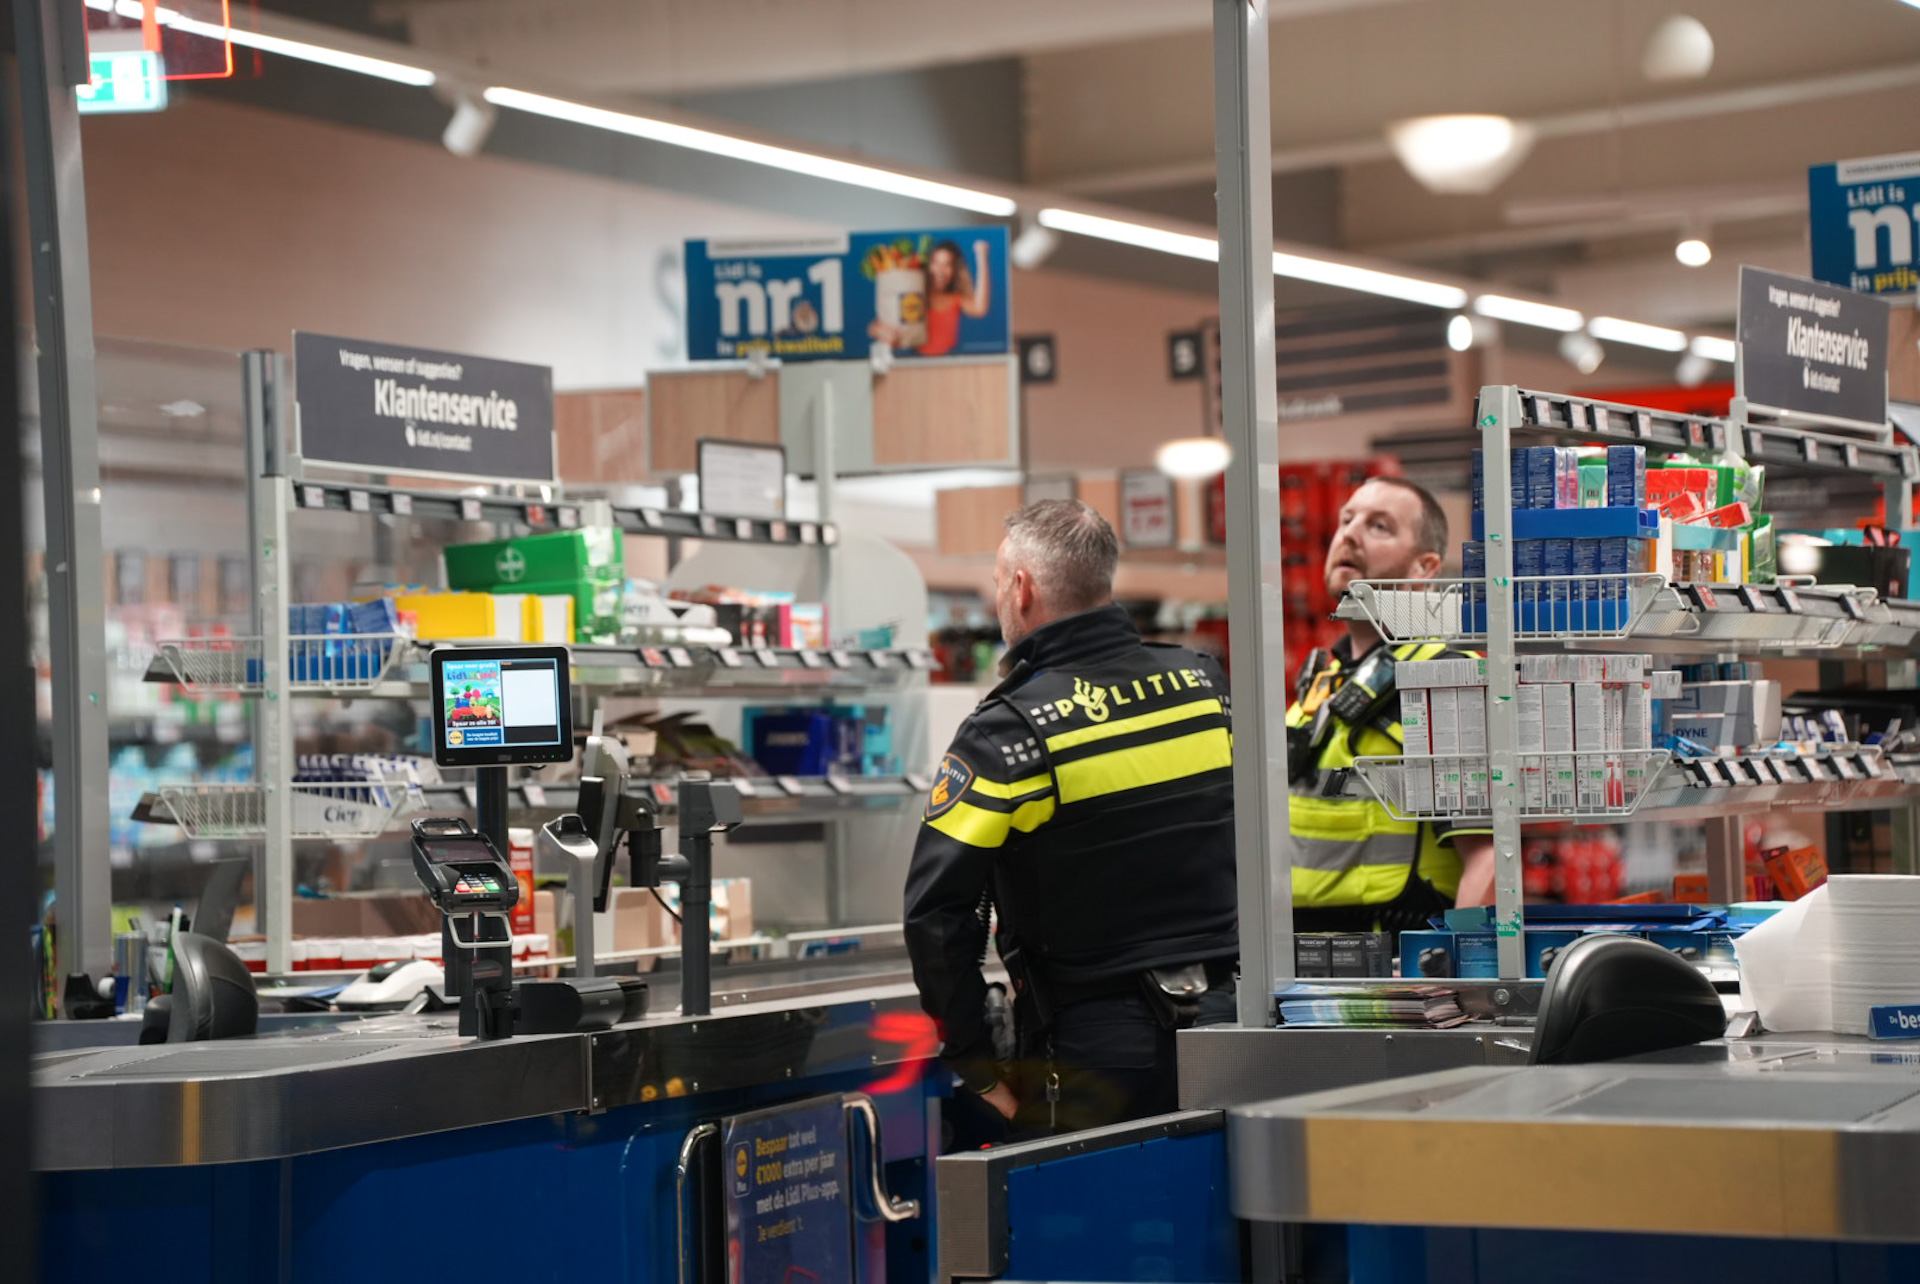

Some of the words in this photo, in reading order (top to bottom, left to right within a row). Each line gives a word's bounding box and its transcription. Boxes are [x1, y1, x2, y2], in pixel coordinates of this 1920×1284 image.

[1847, 185, 1885, 208] Lidl
[1888, 183, 1905, 203] is
[1848, 203, 1920, 270] n
[714, 262, 744, 279] Lidl
[748, 262, 762, 278] is
[1851, 272, 1870, 292] in
[1787, 316, 1868, 371] Klantenservice
[375, 379, 518, 431] Klantenservice
[447, 671, 467, 680] Lidl
[1055, 669, 1201, 723] POLITIE
[1673, 728, 1708, 737] DYNE
[756, 1136, 788, 1158] Bespaar
[788, 1132, 800, 1149] tot
[801, 1125, 816, 1145] wel
[756, 1161, 782, 1185] €1000
[783, 1159, 803, 1178] extra
[804, 1156, 818, 1178] per
[819, 1150, 836, 1174] jaar
[756, 1195, 773, 1215] met
[773, 1190, 784, 1209] de
[785, 1184, 800, 1207] Lidl
[758, 1225, 767, 1243] Je
